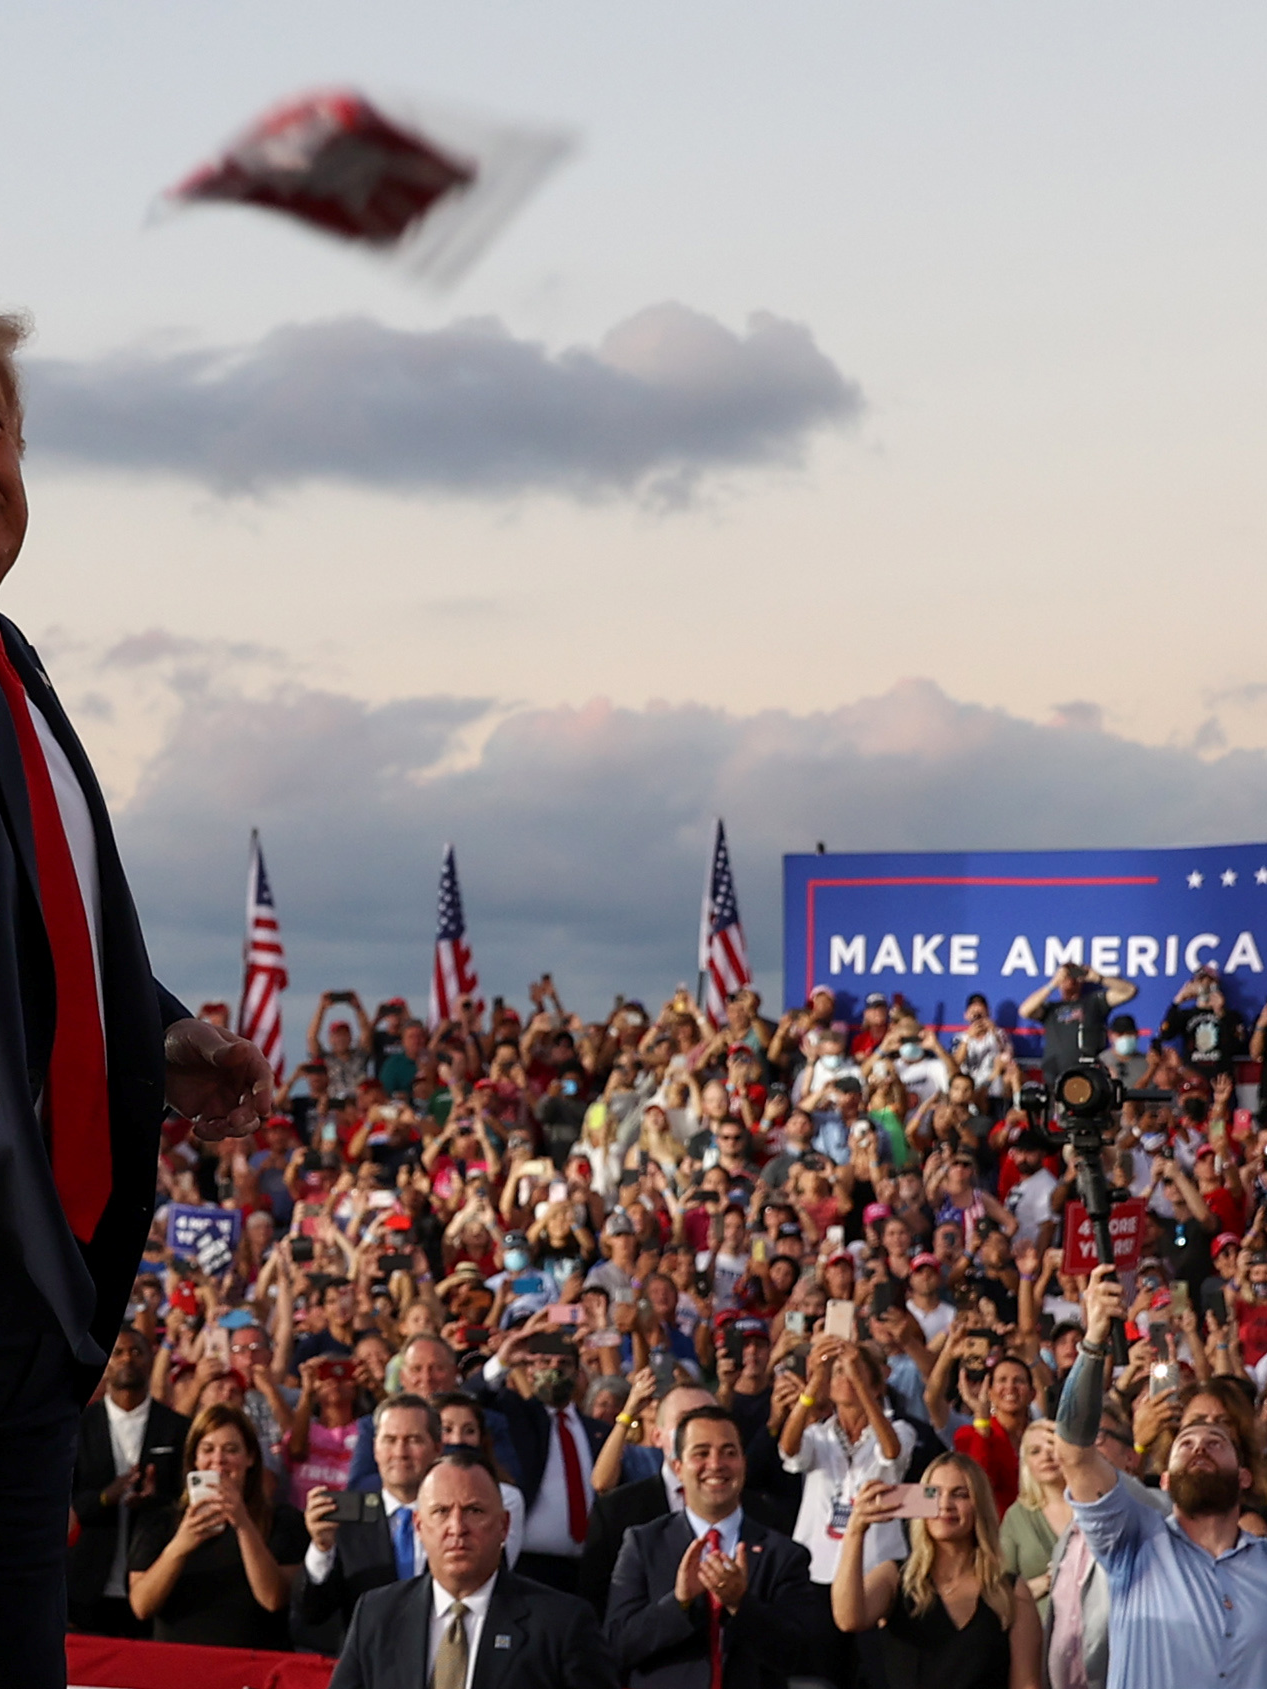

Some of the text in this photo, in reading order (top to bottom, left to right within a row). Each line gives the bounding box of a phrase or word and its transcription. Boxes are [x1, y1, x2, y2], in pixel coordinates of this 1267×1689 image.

[829, 931, 1264, 977] MAKE AMERICA
[1077, 1216, 1137, 1236] 4 ORE
